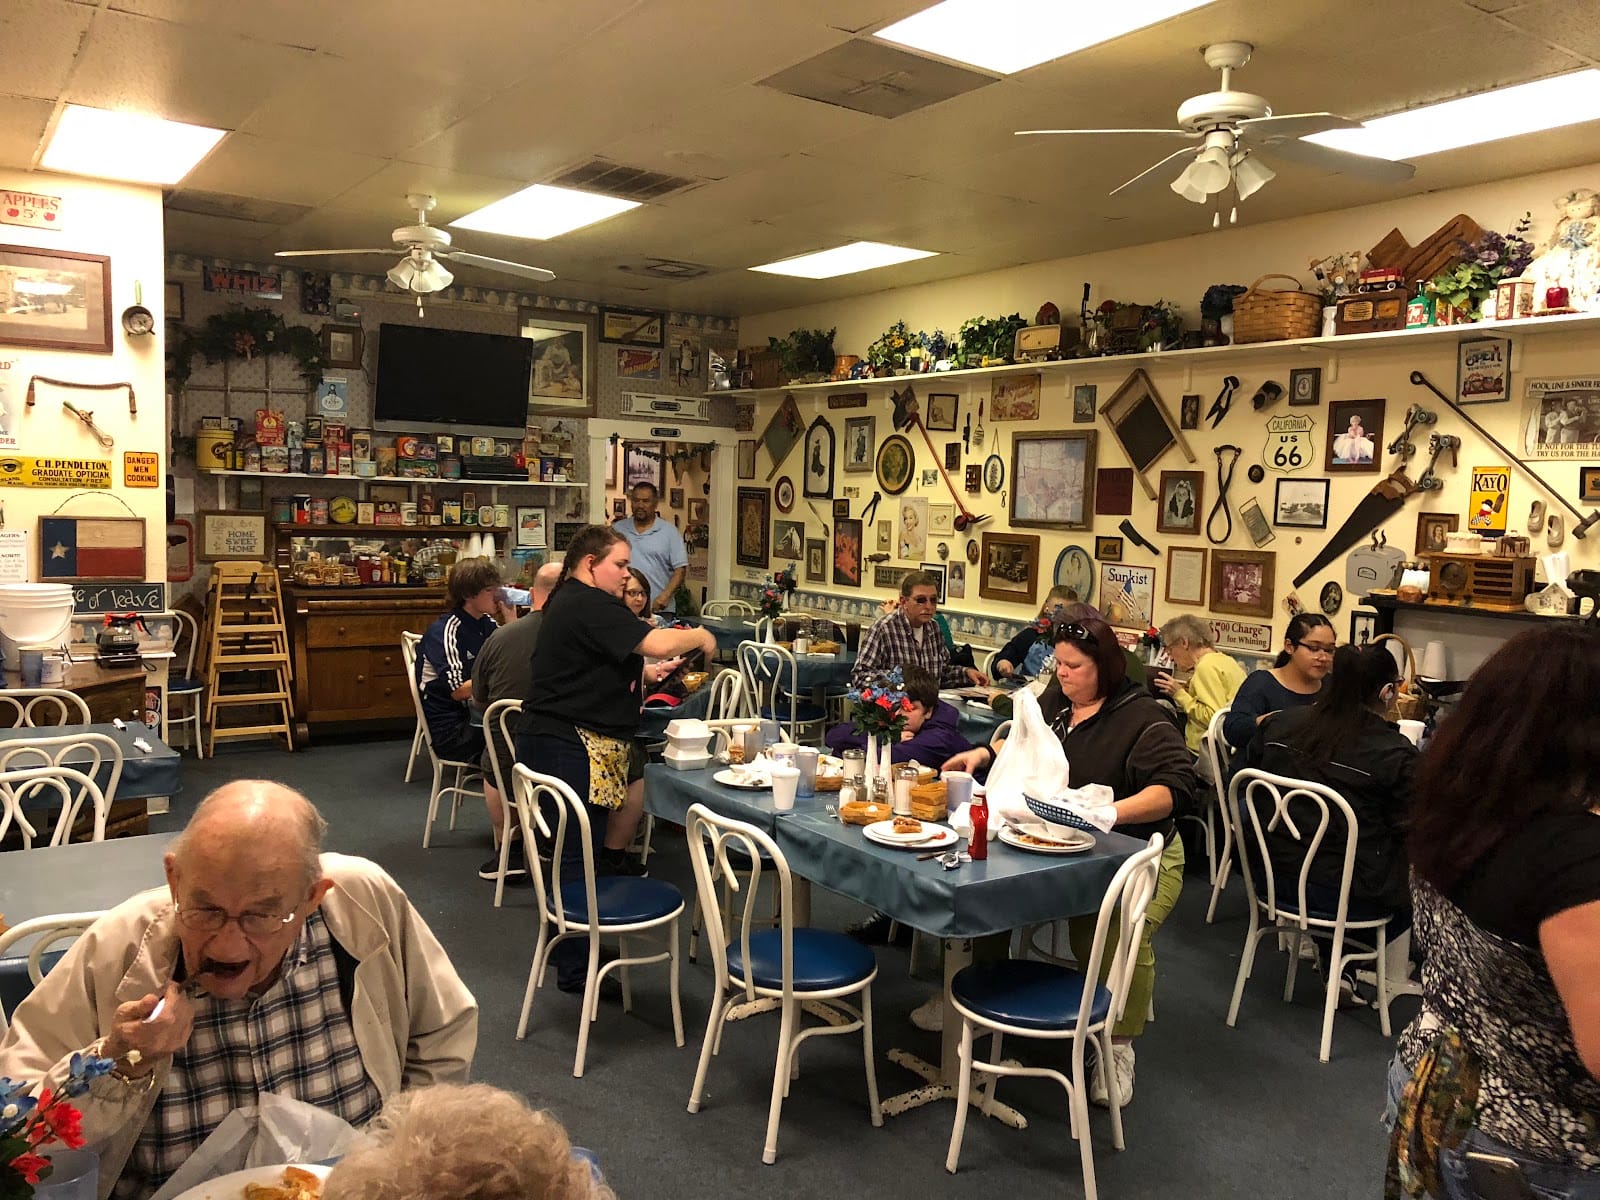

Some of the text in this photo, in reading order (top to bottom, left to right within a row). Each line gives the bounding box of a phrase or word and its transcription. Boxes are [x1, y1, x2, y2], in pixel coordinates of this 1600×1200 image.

[3, 193, 59, 210] APPLES
[209, 270, 278, 293] WHIZ
[1272, 419, 1307, 431] CALIFORNIA
[1273, 445, 1303, 467] 66
[1550, 450, 1559, 458] US
[1560, 450, 1575, 458] FOR
[1576, 450, 1589, 458] THE
[127, 457, 156, 465] DANGER
[31, 468, 73, 478] GRADUATE
[133, 465, 149, 473] MEN
[127, 474, 157, 482] COOKING
[1472, 473, 1508, 492] KAYO
[228, 530, 256, 538] HOME
[228, 545, 256, 553] HOME
[1108, 567, 1149, 585] Sunkist
[88, 588, 108, 610] or
[110, 588, 160, 610] leave
[1231, 623, 1263, 638] Charge
[1226, 635, 1267, 649] for Whining
